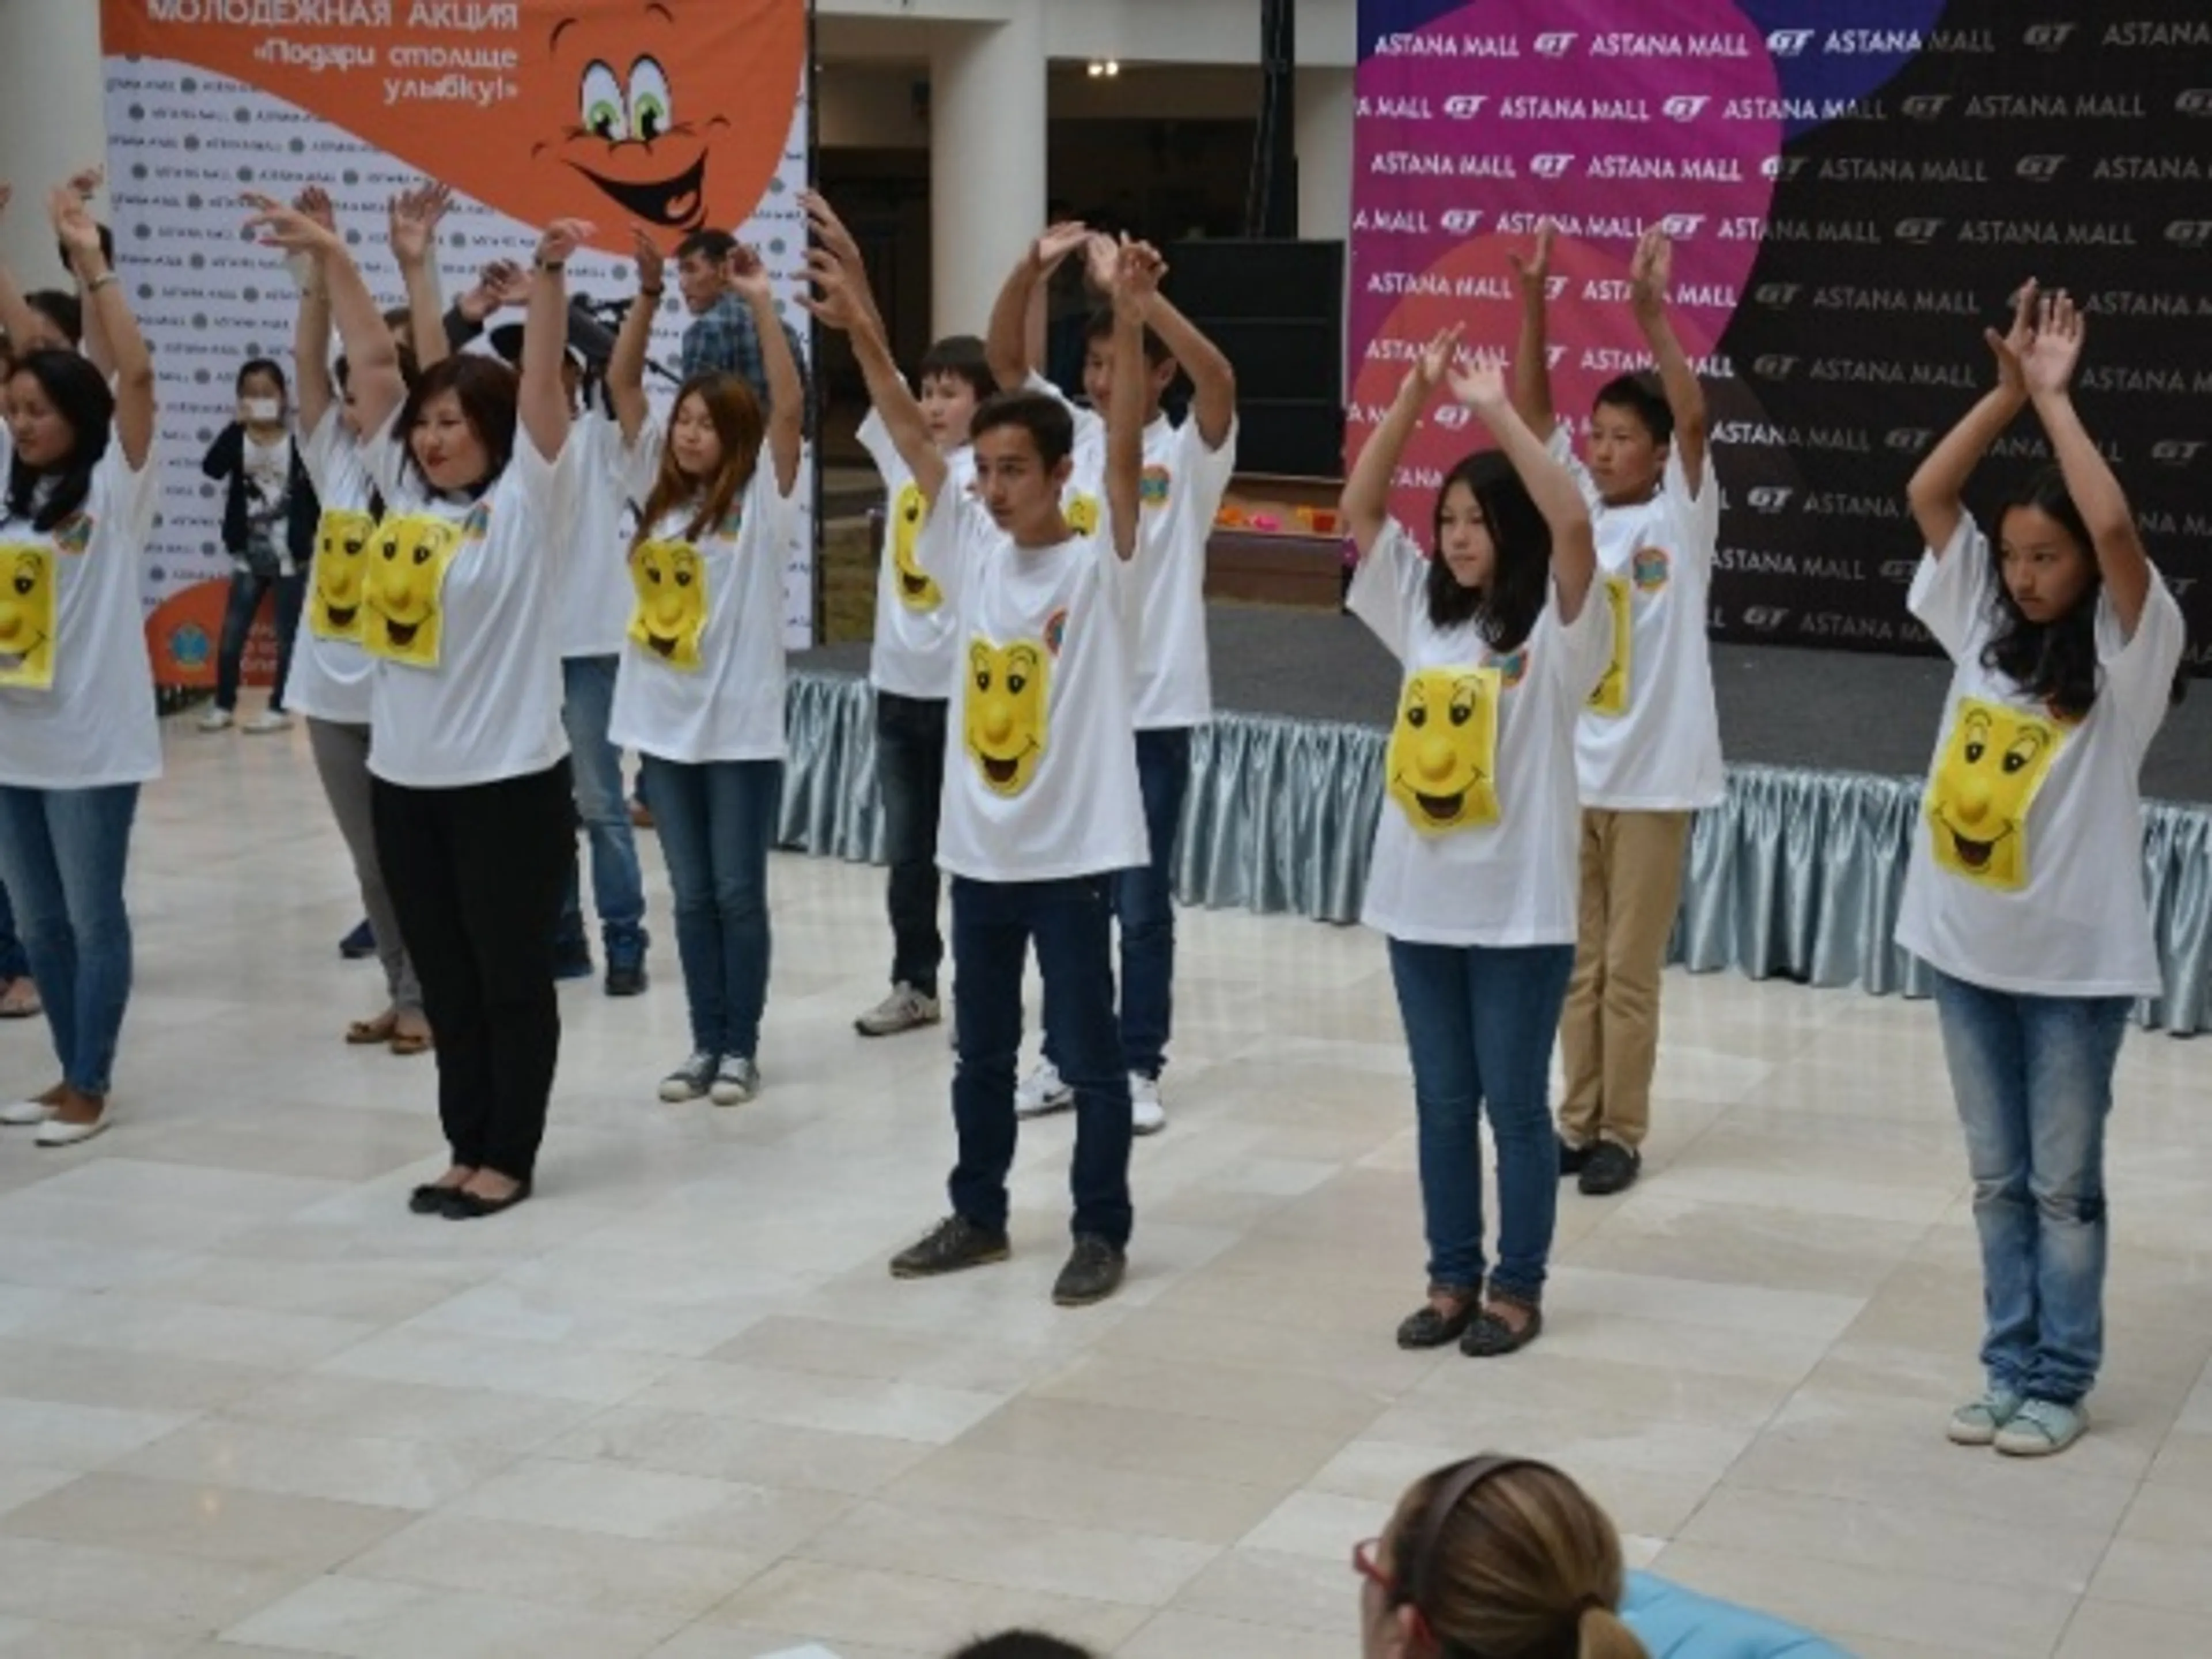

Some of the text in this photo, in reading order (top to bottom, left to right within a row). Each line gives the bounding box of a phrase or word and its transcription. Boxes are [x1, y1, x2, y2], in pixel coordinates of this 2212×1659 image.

[408, 3, 518, 32] АКЦИЯ
[1374, 33, 1458, 56] ASTANA
[1462, 33, 1520, 56] MALL
[1589, 33, 1683, 56] ASTANA
[1688, 33, 1749, 56] MALL
[1823, 29, 1922, 53] ASTANA
[1927, 29, 1995, 52] MALL
[389, 46, 518, 70] столице
[1376, 96, 1433, 119] MALL
[1499, 96, 1586, 119] ASTANA
[1592, 99, 1650, 121] MALL
[1722, 97, 1819, 120] ASTANA
[1821, 98, 1888, 121] MALL
[1964, 94, 2068, 118] ASTANA
[2075, 93, 2146, 118] MALL
[1370, 151, 1453, 175] ASTANA
[1459, 154, 1517, 178] MALL
[1586, 154, 1675, 178] ASTANA
[1680, 157, 1743, 182] MALL
[1819, 157, 1915, 180] ASTANA
[1920, 158, 1990, 183] MALL
[2093, 156, 2202, 180] ASTANA
[1372, 208, 1430, 233] MALL
[1717, 217, 1810, 241] ASTANA
[1816, 219, 1881, 244] MALL
[1957, 219, 2061, 244] ASTANA
[2065, 222, 2137, 245] MALL
[1367, 272, 1452, 296] ASTANA
[1456, 276, 1513, 300] MALL
[1677, 283, 1737, 307] MALL
[1813, 286, 1908, 311] ASTANA
[1913, 289, 1980, 315] MALL
[2084, 290, 2191, 316] ASTANA
[1809, 357, 1906, 382] ASTANA
[2080, 364, 2187, 392] ASTANA
[1710, 419, 1804, 447] ASTANA
[1803, 493, 1899, 518] ASTANA
[1803, 556, 1866, 580] MALL
